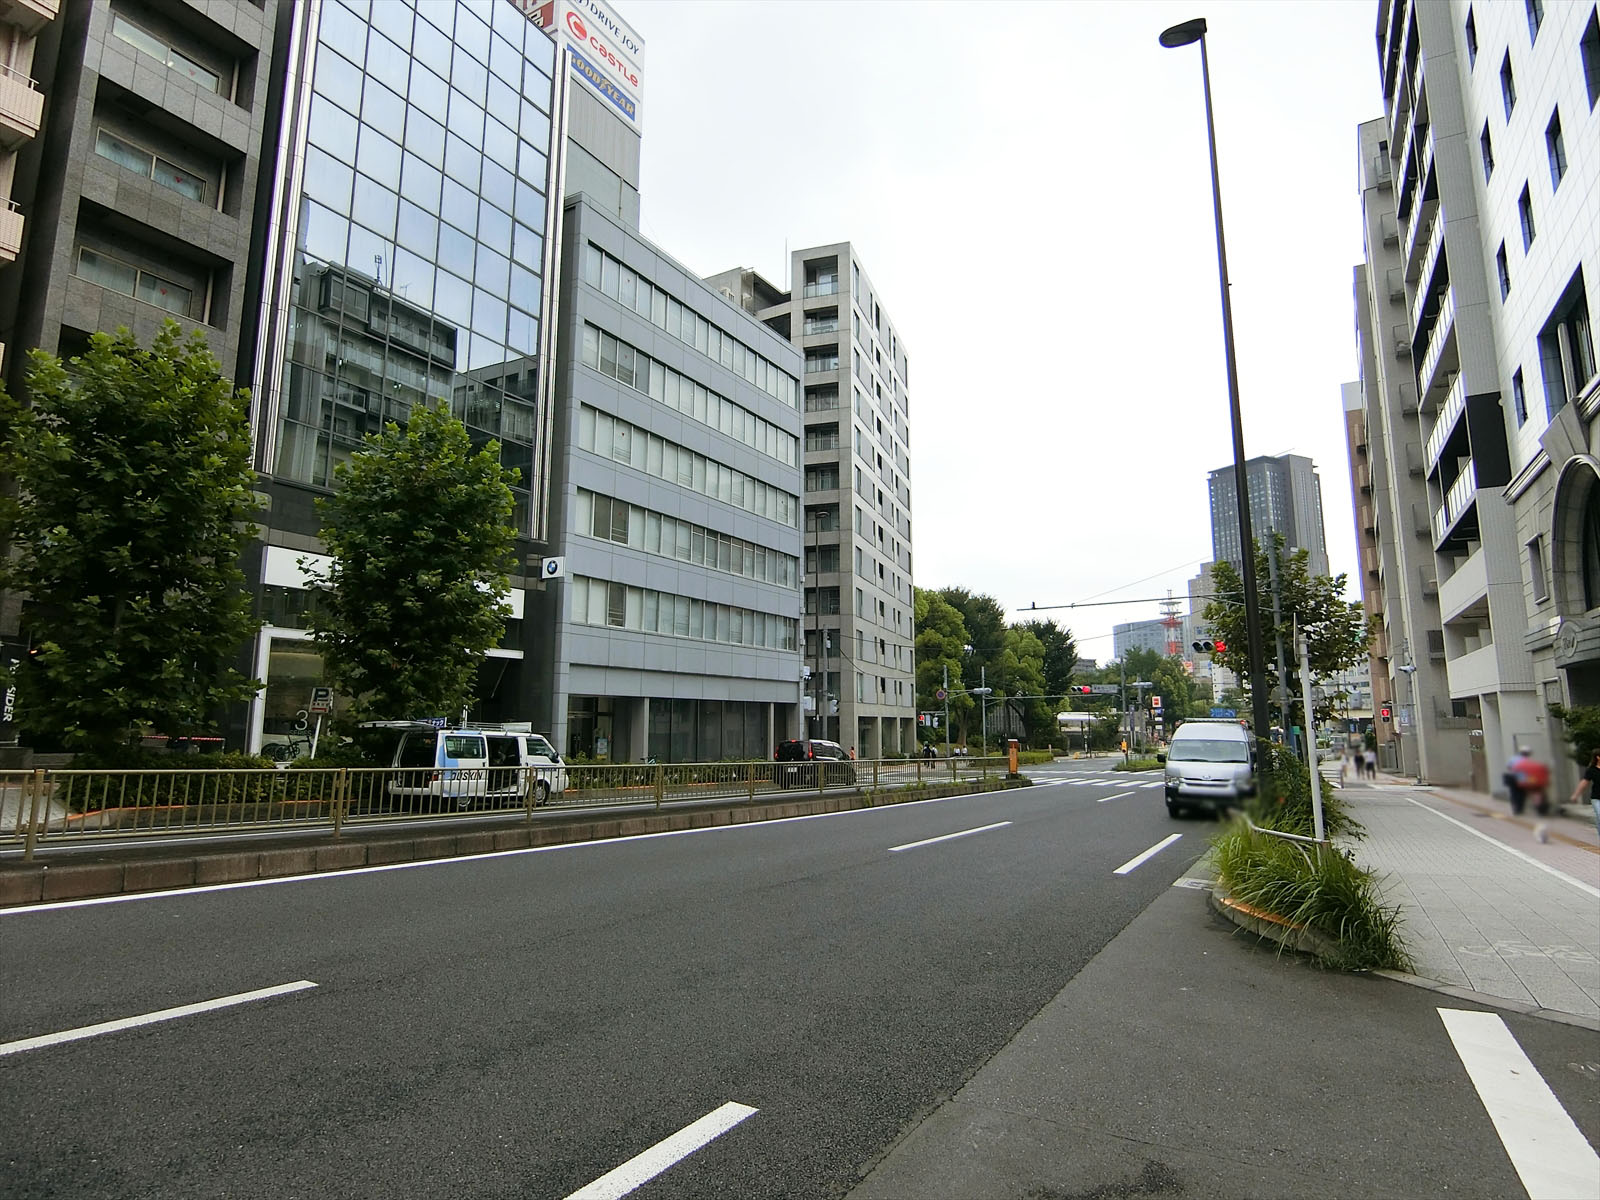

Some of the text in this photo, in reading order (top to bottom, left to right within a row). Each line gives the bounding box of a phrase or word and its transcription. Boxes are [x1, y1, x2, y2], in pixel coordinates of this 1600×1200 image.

[590, 3, 639, 54] DRIVE JOY
[295, 710, 309, 730] 3
